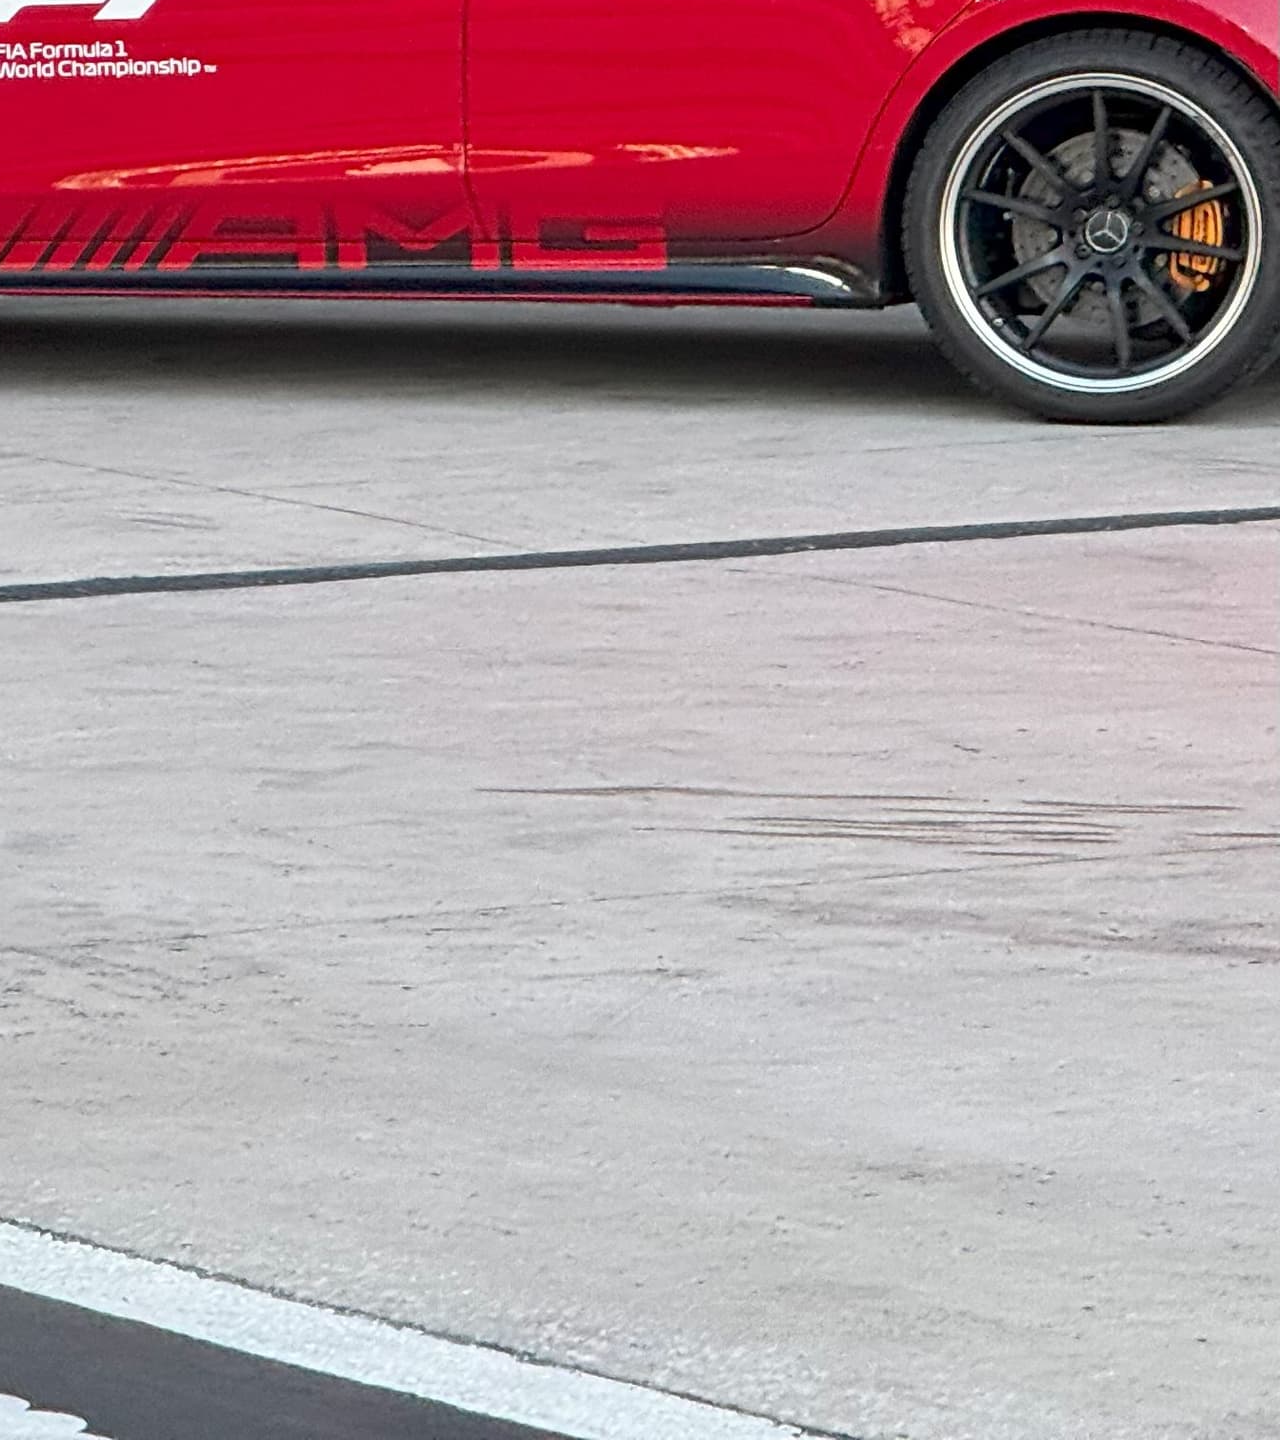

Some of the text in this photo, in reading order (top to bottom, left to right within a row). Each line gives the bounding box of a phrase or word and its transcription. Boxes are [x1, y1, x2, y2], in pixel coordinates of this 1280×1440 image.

[30, 41, 114, 59] Formula
[115, 40, 129, 57] 1
[58, 56, 202, 78] Championship
